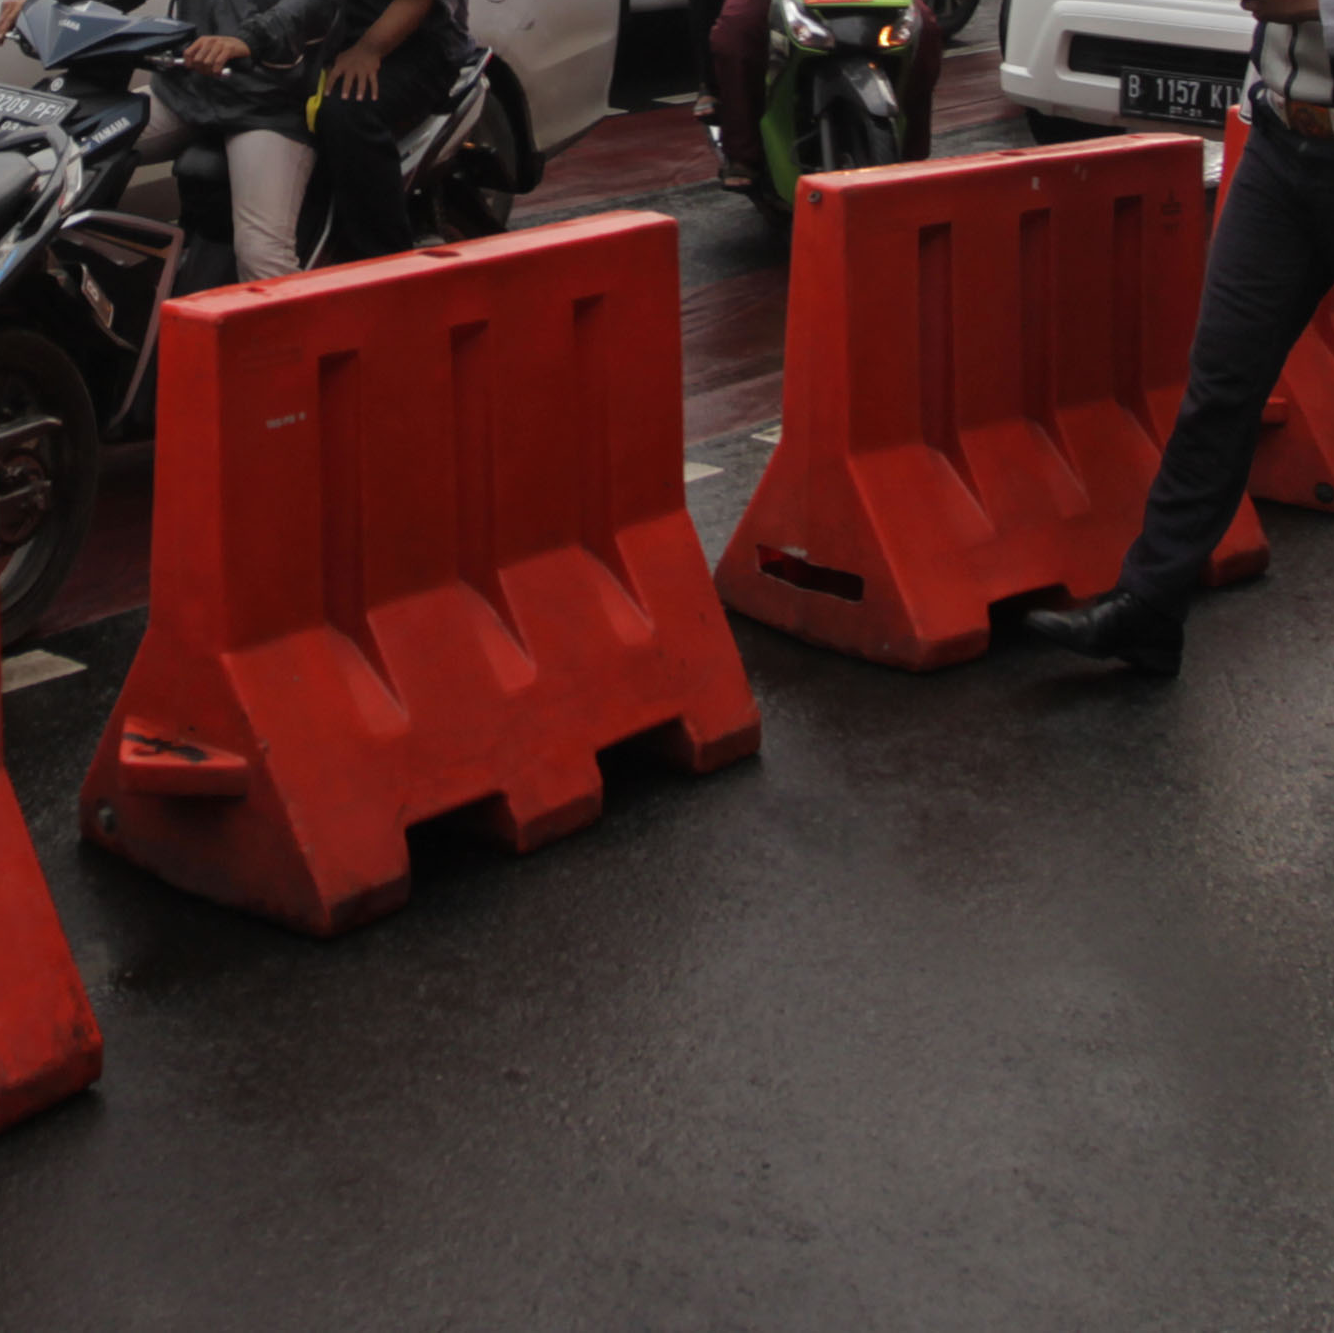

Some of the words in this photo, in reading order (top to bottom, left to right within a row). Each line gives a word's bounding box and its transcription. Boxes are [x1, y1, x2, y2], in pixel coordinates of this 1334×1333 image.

[1128, 74, 1141, 99] B
[1156, 77, 1201, 106] 1157
[91, 117, 132, 144] YAMAHA
